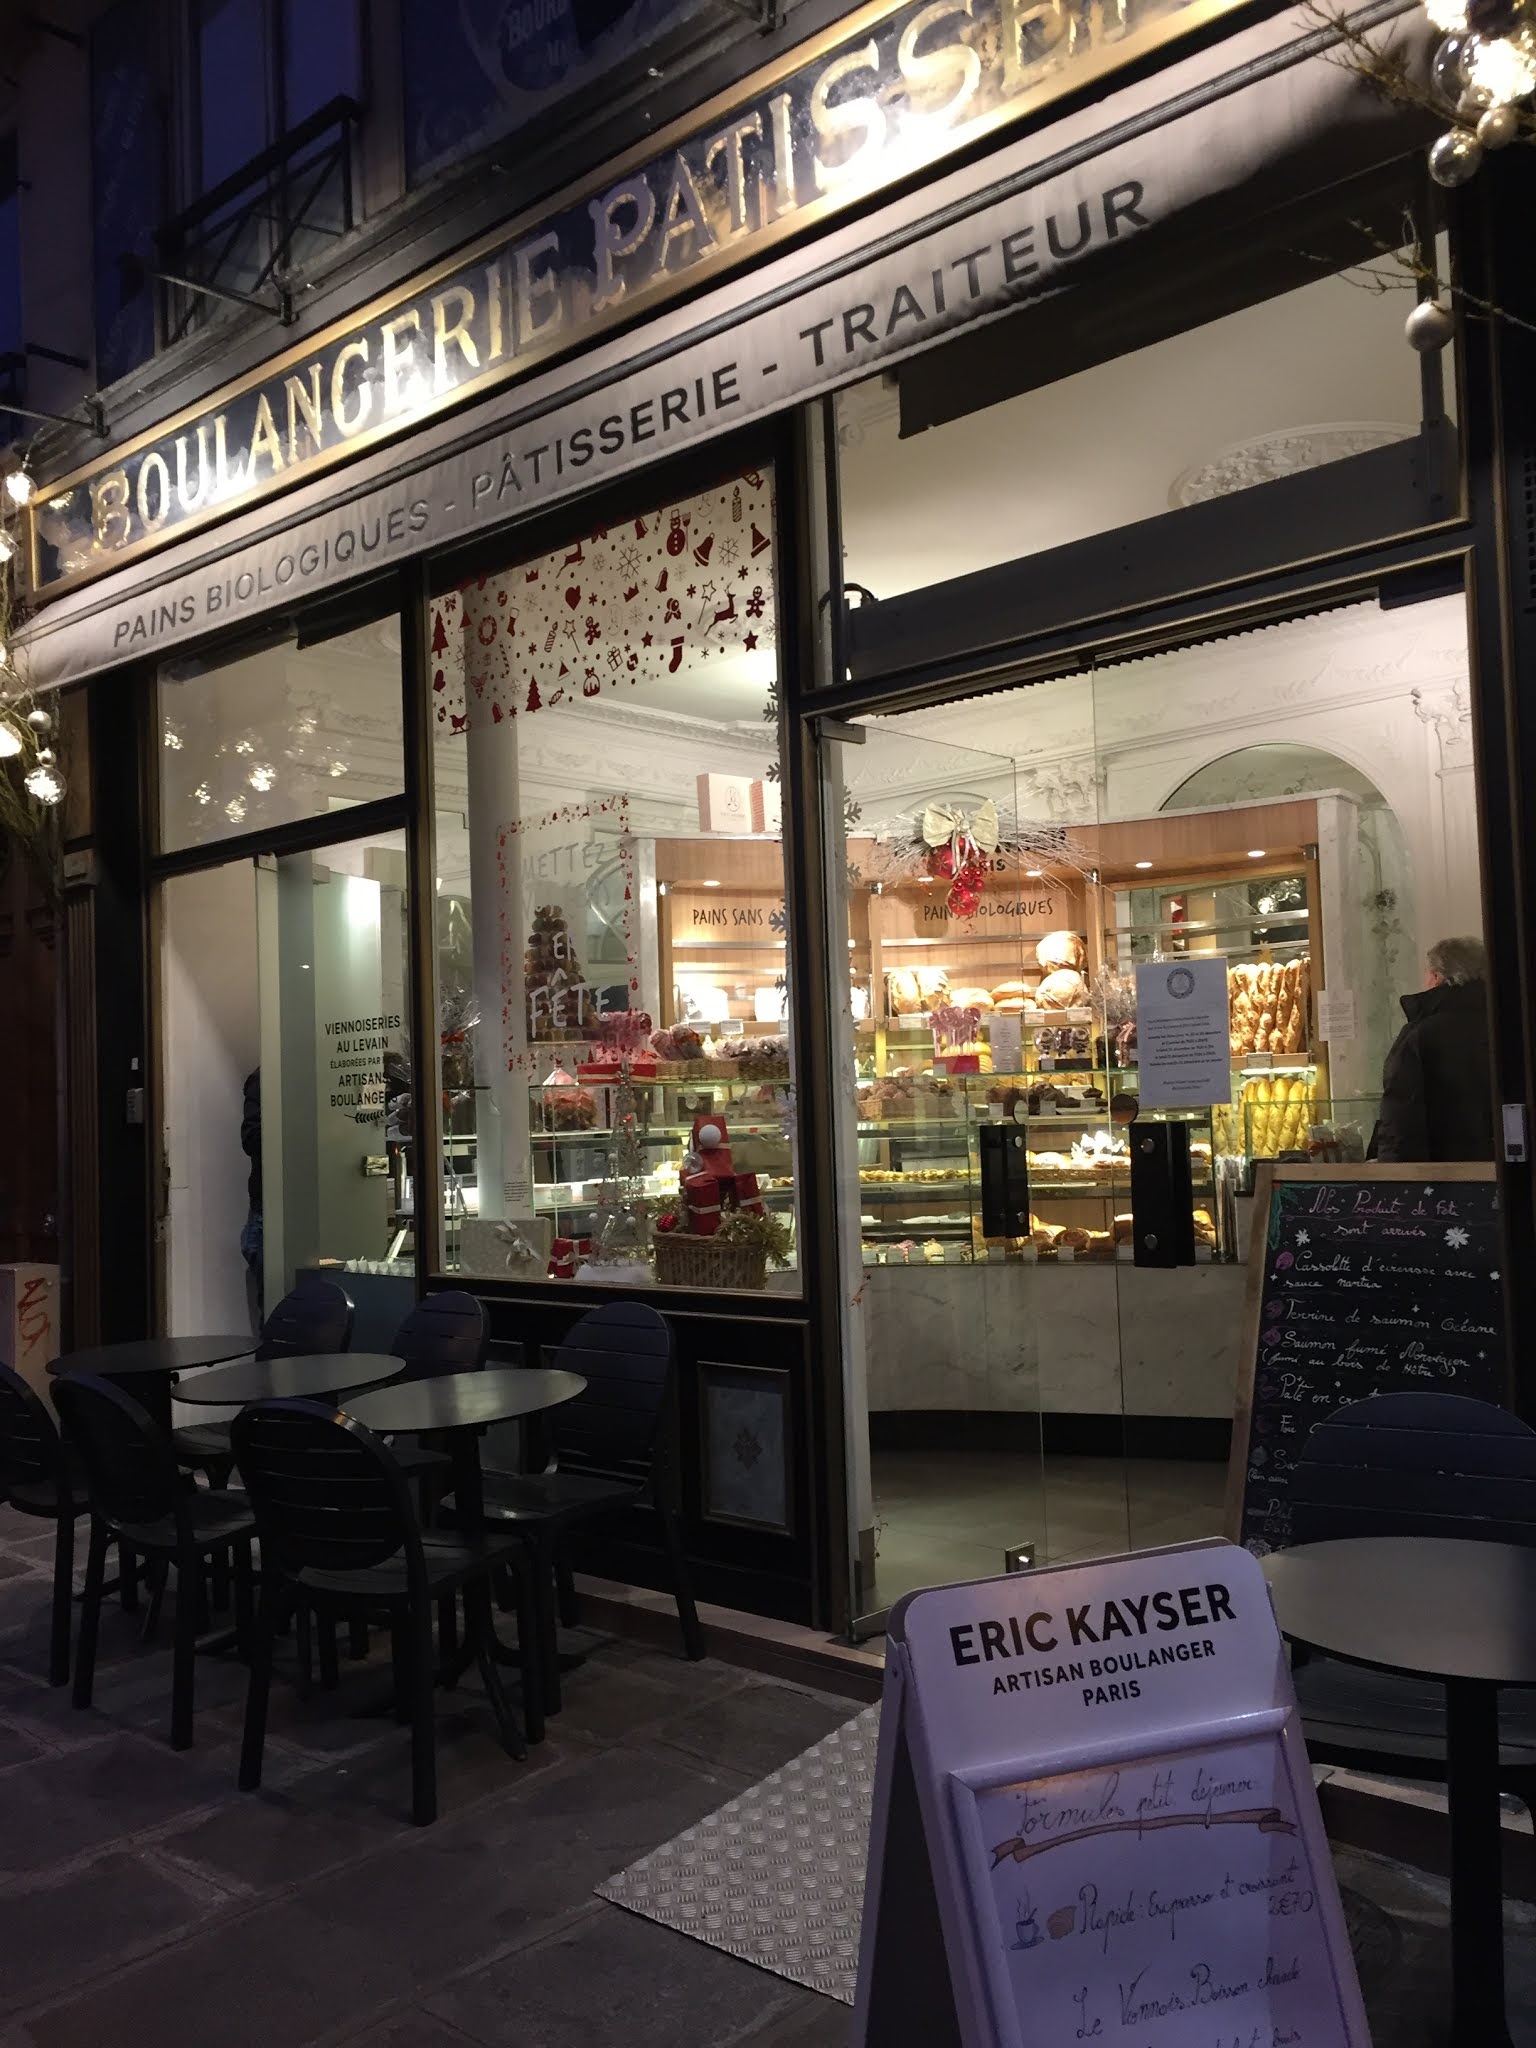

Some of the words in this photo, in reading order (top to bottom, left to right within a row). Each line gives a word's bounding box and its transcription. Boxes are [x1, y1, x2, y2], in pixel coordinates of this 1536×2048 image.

[90, 232, 563, 550] BOULANGERIE
[113, 599, 196, 648] PAINS
[205, 501, 429, 613] BIOLOGIQUES
[471, 361, 741, 510] PÂTISSERIE
[799, 180, 1150, 369] TRAITEUR
[693, 908, 728, 926] PAINS
[732, 907, 764, 926] SANS
[529, 967, 611, 1038] FÊTE
[325, 1015, 401, 1035] VIENNOISERIES
[336, 1040, 350, 1053] AU
[353, 1036, 389, 1052] LEVAIN
[1309, 1186, 1341, 1215] Nos
[1411, 1200, 1427, 1217] de
[1333, 1220, 1374, 1237] sont
[1283, 1277, 1324, 1288] sauce
[1444, 1269, 1476, 1279] avec
[1286, 1299, 1336, 1323] Terrine
[1345, 1309, 1361, 1324] de
[1370, 1314, 1430, 1329] saumon
[1280, 1331, 1337, 1350] Saumon
[1375, 1359, 1391, 1372] de
[948, 1611, 1058, 1667] ERIC
[1065, 1583, 1237, 1647] KAYSER
[992, 1661, 1085, 1696] ARTISAN
[1089, 1639, 1217, 1677] BOULANGER
[1081, 1679, 1142, 1708] PARIS
[1073, 1985, 1104, 2039] Le
